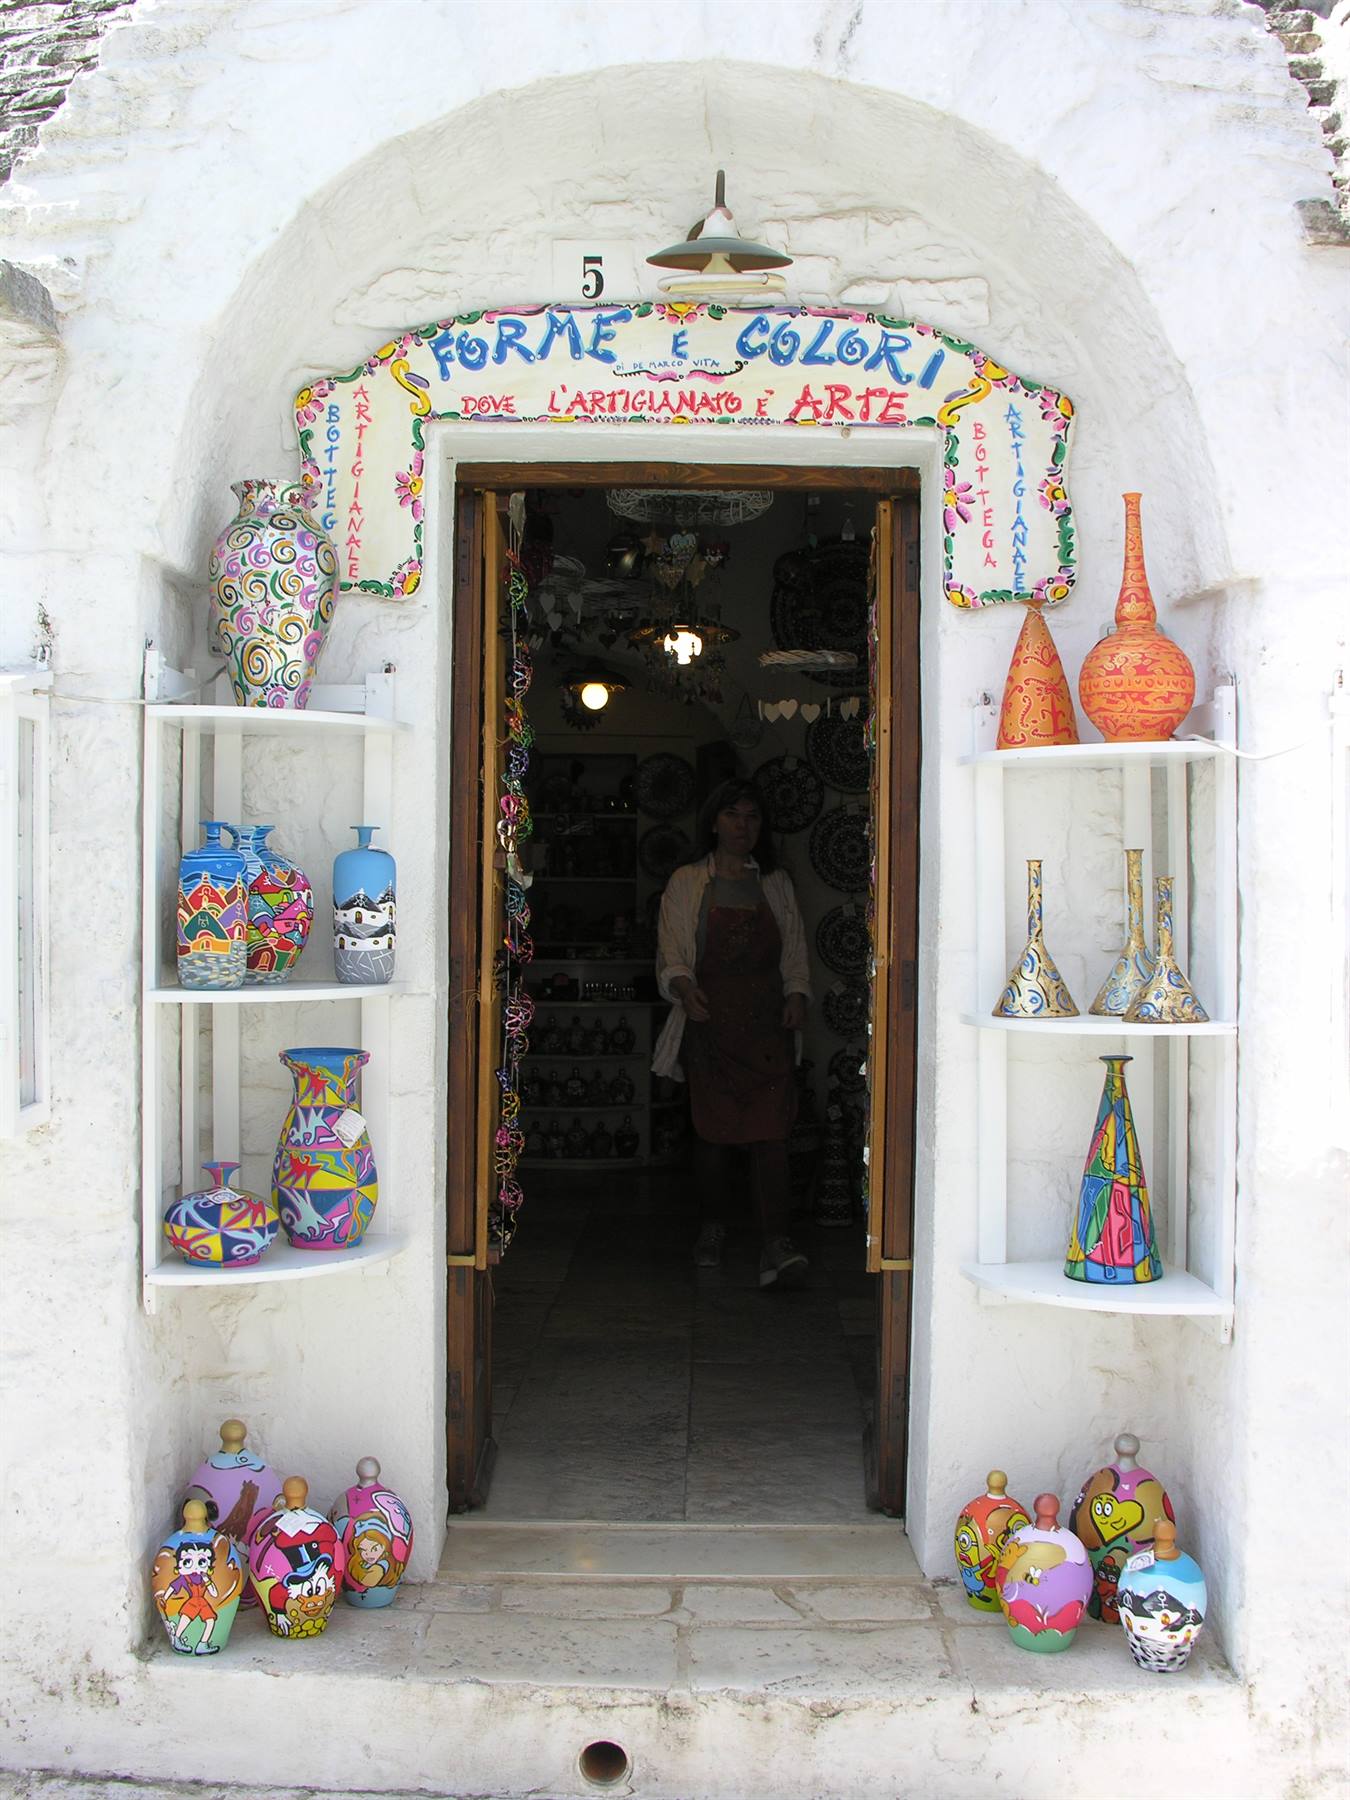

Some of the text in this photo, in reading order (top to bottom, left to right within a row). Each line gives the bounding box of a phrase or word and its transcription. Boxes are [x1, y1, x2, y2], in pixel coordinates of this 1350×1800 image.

[582, 256, 604, 299] 5
[428, 309, 945, 390] FORME E COLORI
[461, 395, 517, 415] DOVE
[547, 384, 742, 415] L'ARTIGIANATO
[788, 384, 909, 423] ARTE
[633, 361, 644, 370] DE
[649, 360, 684, 369] MARCO
[692, 358, 721, 368] VITA
[322, 404, 341, 547] BOTTEG
[346, 384, 373, 579] ARTIGIANALE
[972, 422, 998, 568] BOTTEGA
[1003, 403, 1029, 592] ARTIGIANALE
